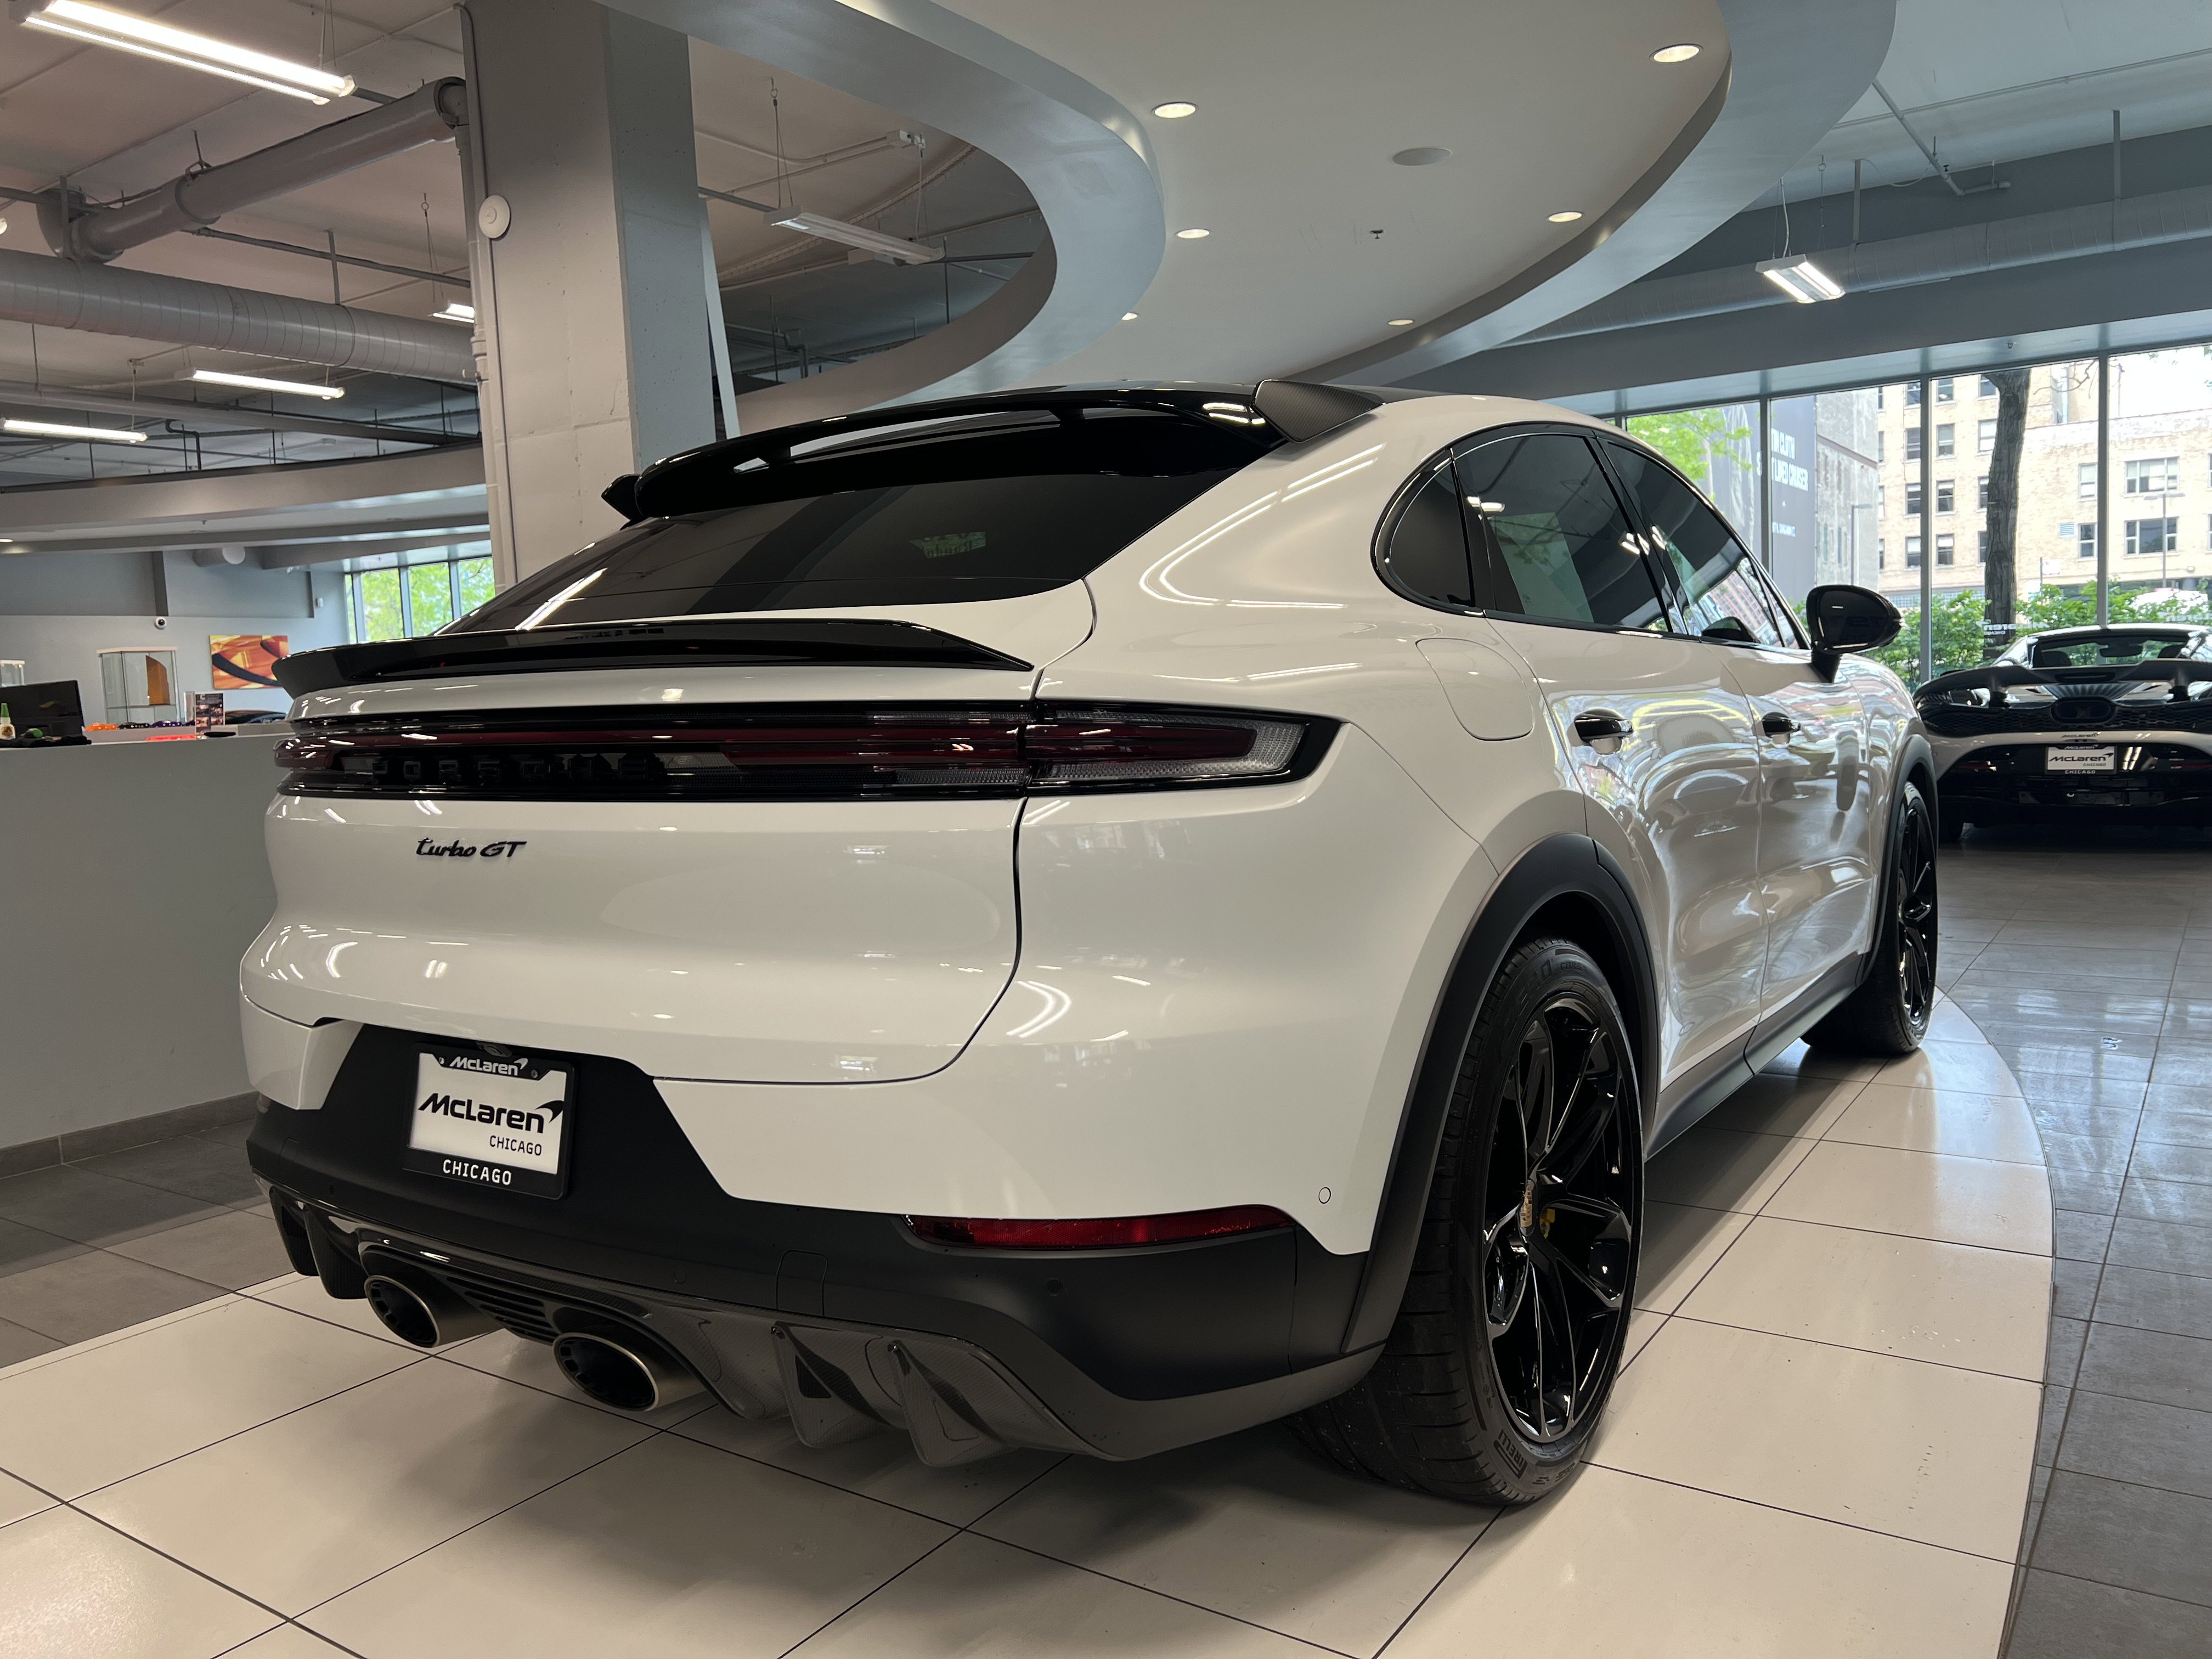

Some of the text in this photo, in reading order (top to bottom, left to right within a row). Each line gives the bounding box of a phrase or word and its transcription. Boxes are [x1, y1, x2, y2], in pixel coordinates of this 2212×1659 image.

[416, 837, 527, 857] turbo GT
[449, 1056, 518, 1076] McLaren
[418, 1093, 544, 1134] McLaren
[489, 1135, 542, 1156] CHICAGO
[443, 1159, 512, 1186] CHICAGO
[1493, 1429, 1528, 1480] PIRELLI
